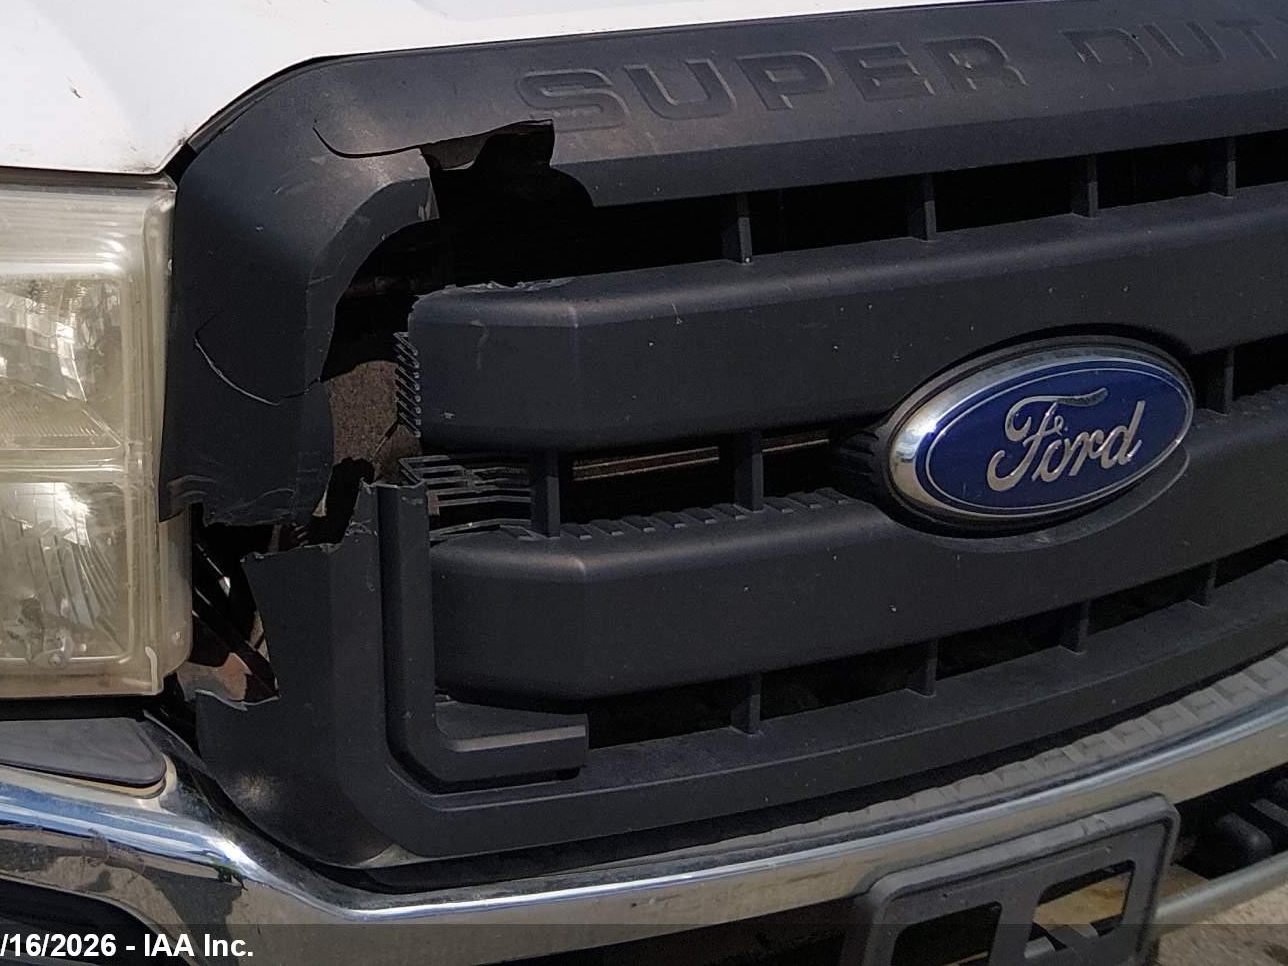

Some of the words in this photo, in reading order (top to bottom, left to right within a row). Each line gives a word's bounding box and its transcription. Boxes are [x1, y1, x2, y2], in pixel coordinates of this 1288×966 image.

[516, 35, 1029, 133] SUPER
[1058, 17, 1288, 69] DUT
[987, 387, 1146, 491] Ford
